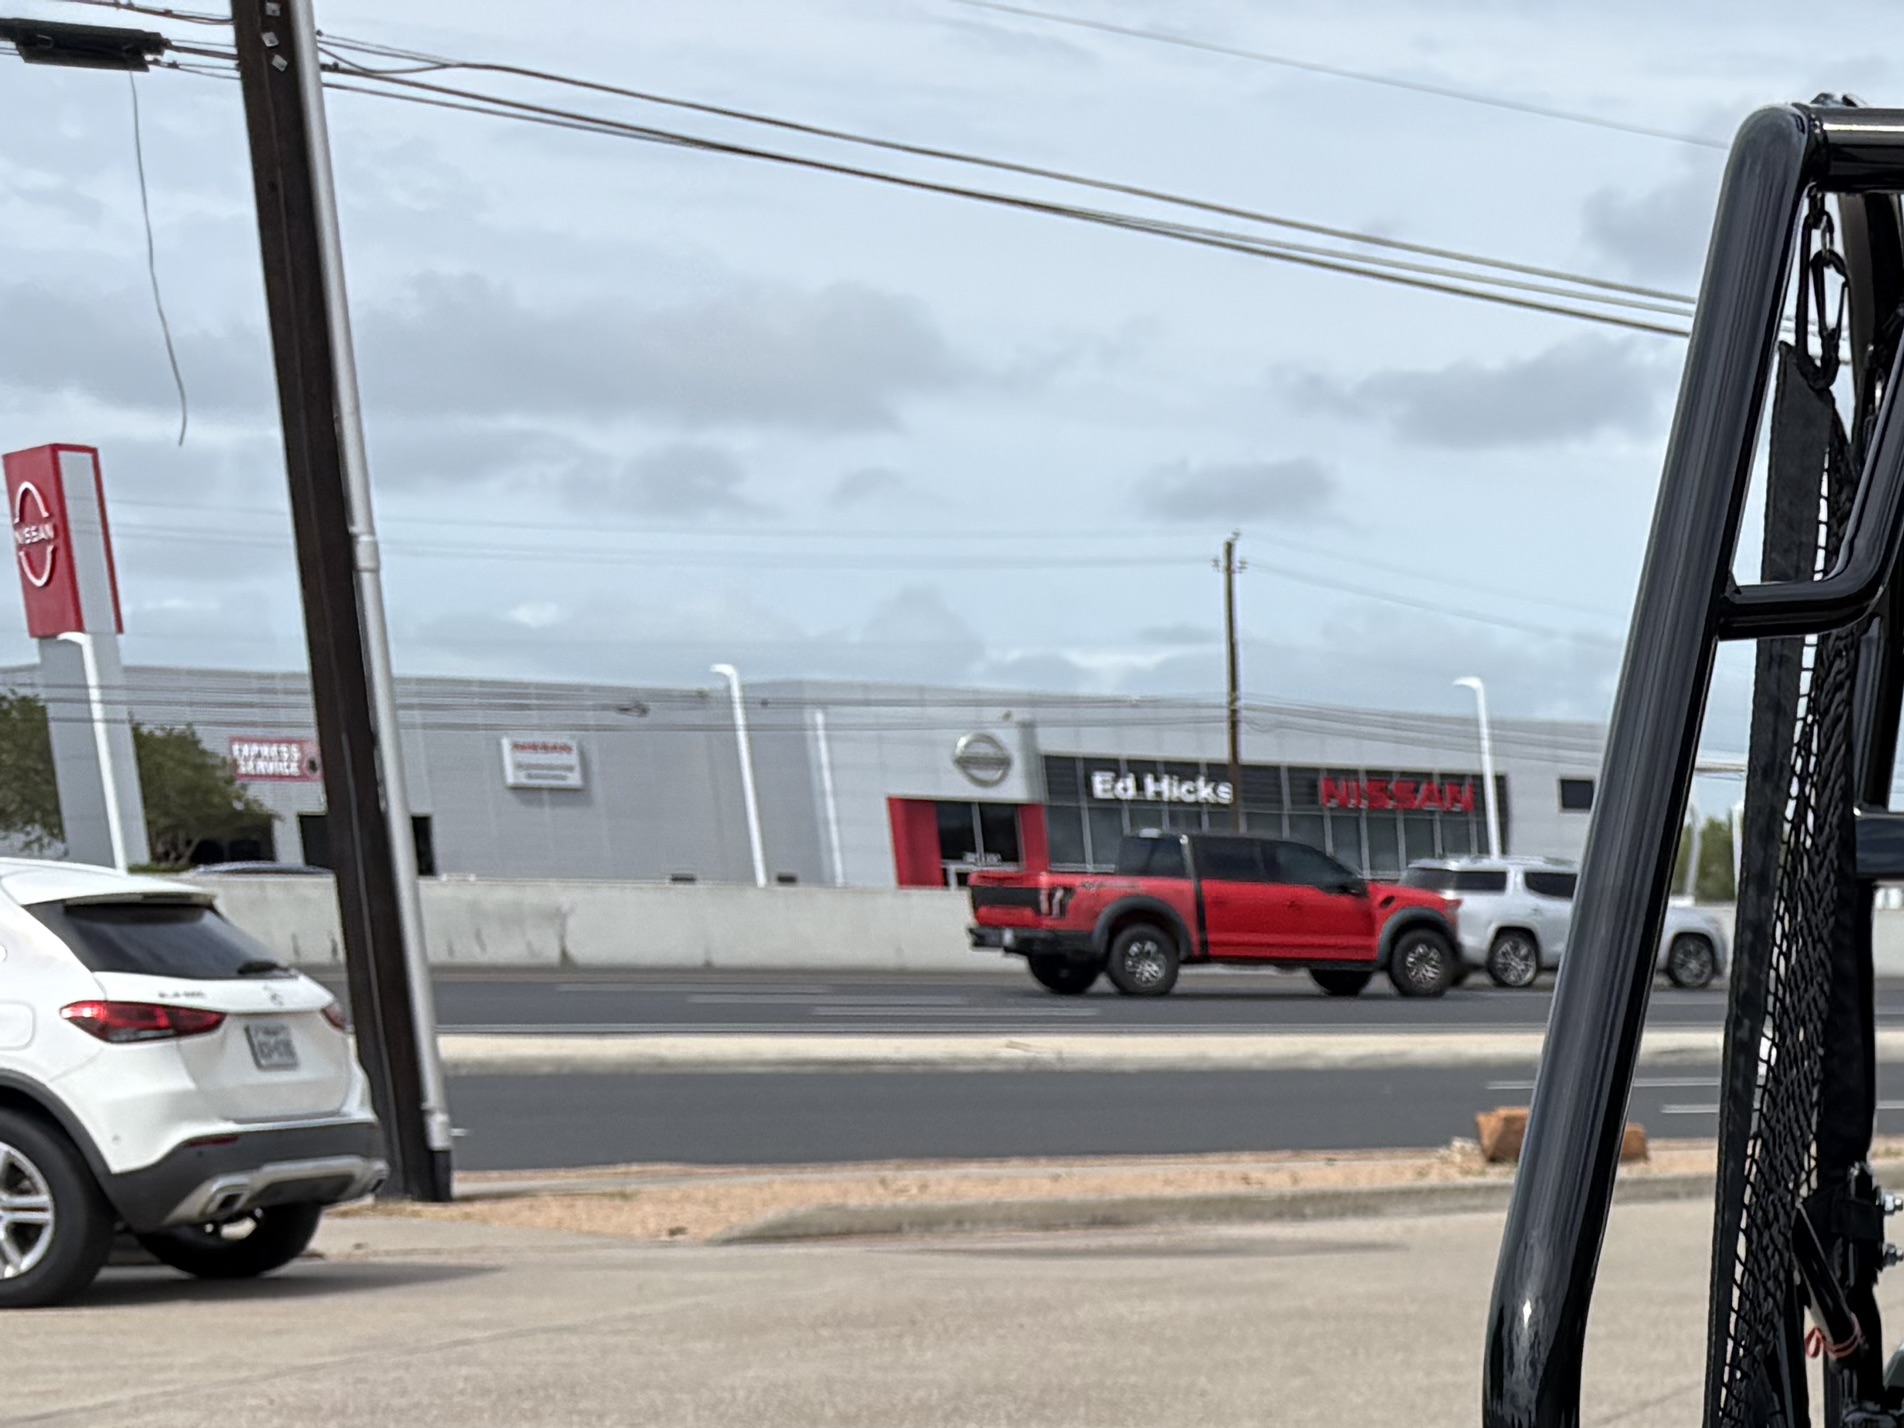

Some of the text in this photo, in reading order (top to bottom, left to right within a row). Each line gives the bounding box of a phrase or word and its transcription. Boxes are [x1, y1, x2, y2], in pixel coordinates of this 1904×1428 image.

[15, 523, 55, 545] NISSAN
[1092, 771, 1234, 804] Ed Hicks
[1321, 776, 1475, 812] NISSAN
